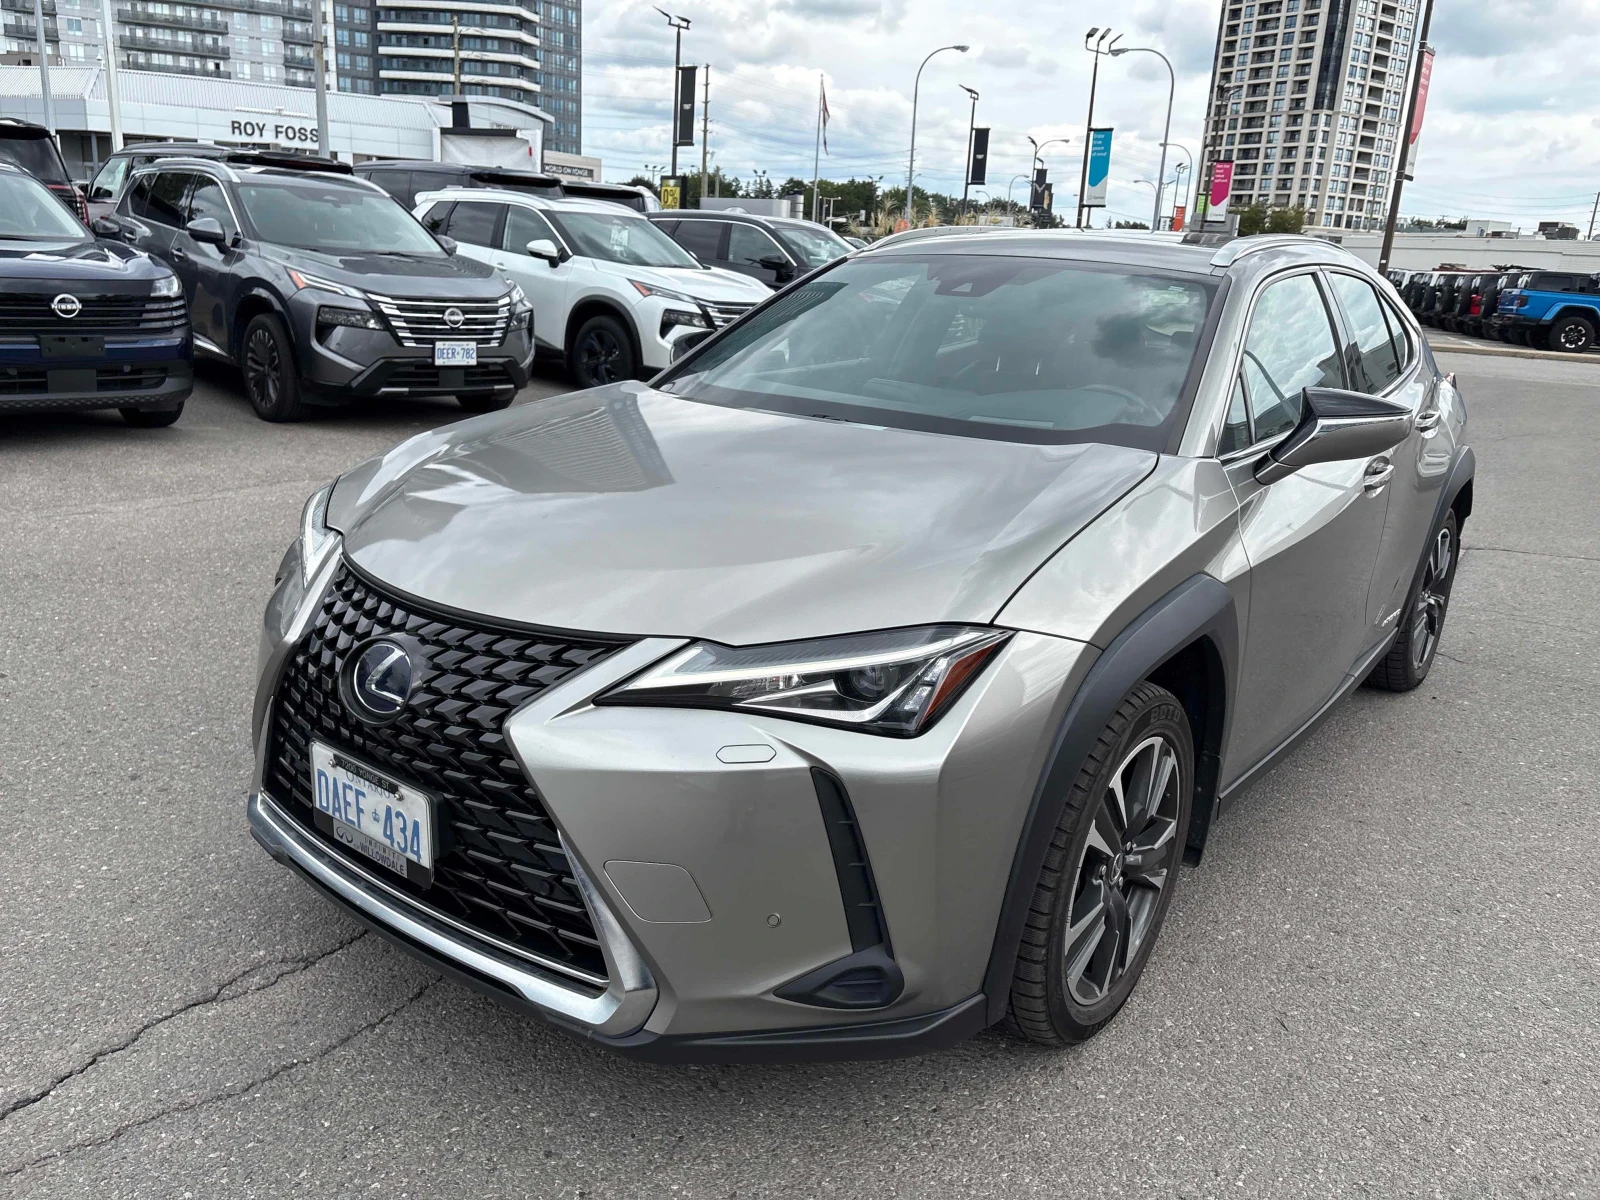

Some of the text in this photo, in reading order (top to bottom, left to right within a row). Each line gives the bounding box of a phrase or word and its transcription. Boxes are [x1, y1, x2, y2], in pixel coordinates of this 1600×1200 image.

[231, 119, 318, 143] ROY FOSS
[544, 164, 563, 174] WORLD
[663, 188, 679, 205] 0%
[436, 347, 476, 360] DEER 782
[359, 769, 379, 786] YONGE
[317, 768, 422, 863] DAEF 434
[360, 842, 405, 876] WILLOWDALE
